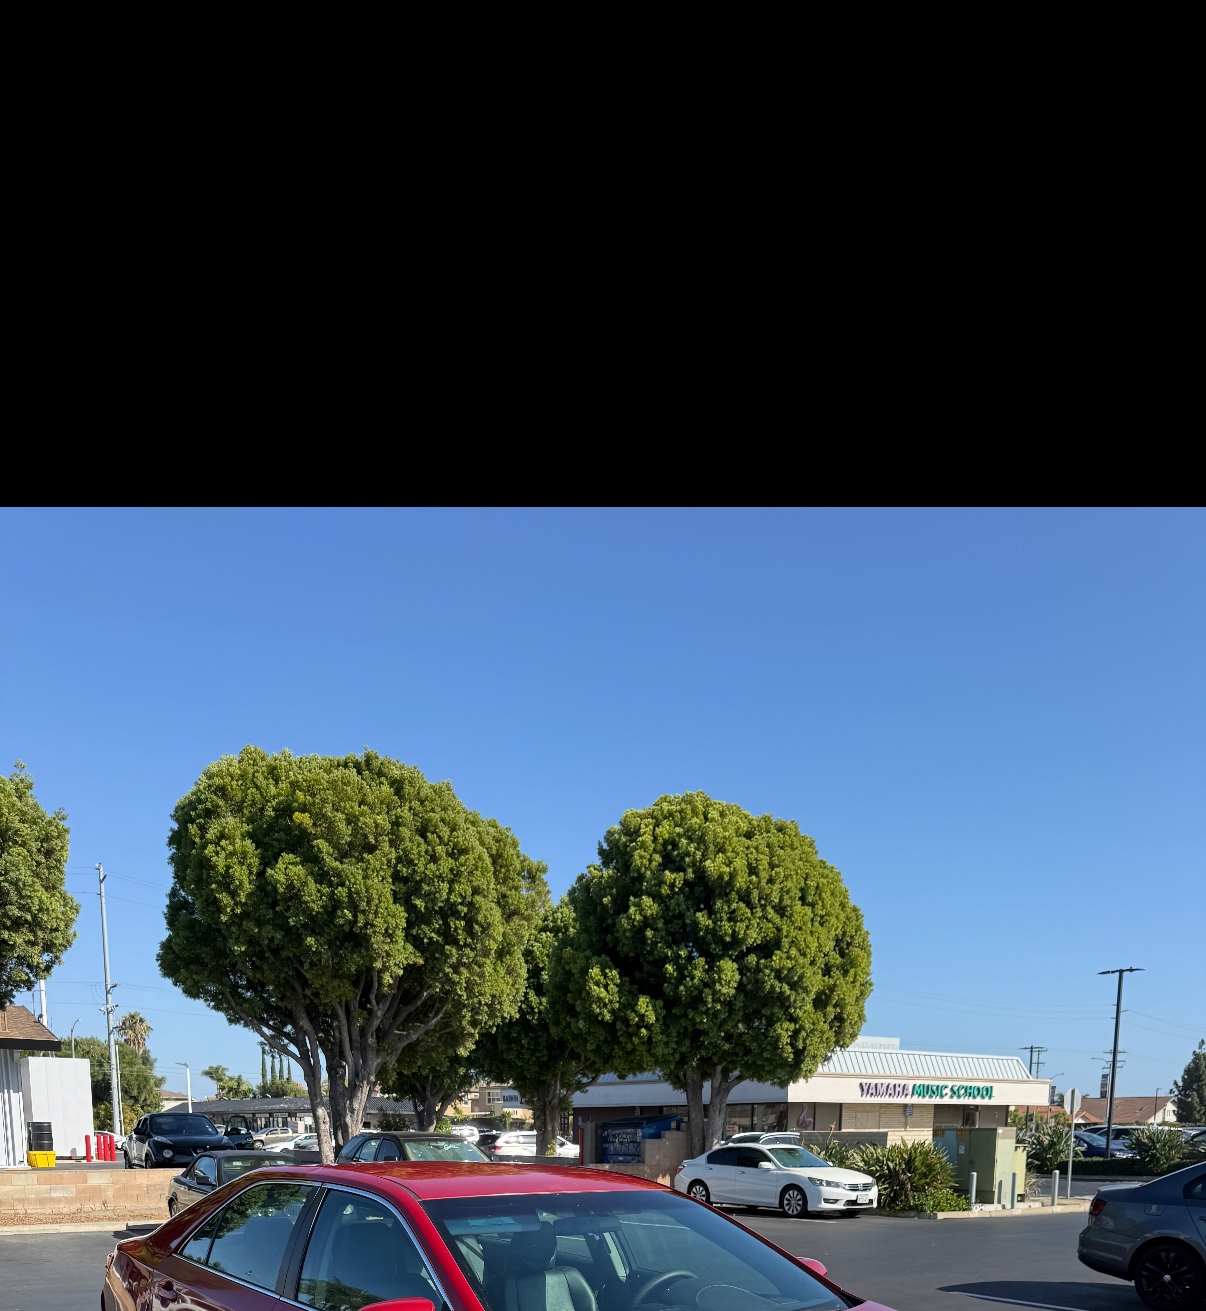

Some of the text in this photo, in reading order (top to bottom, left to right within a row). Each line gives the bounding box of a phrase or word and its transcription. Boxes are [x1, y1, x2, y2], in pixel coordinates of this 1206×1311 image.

[859, 1082, 994, 1100] YAMAHA MUSIC SCHOOL
